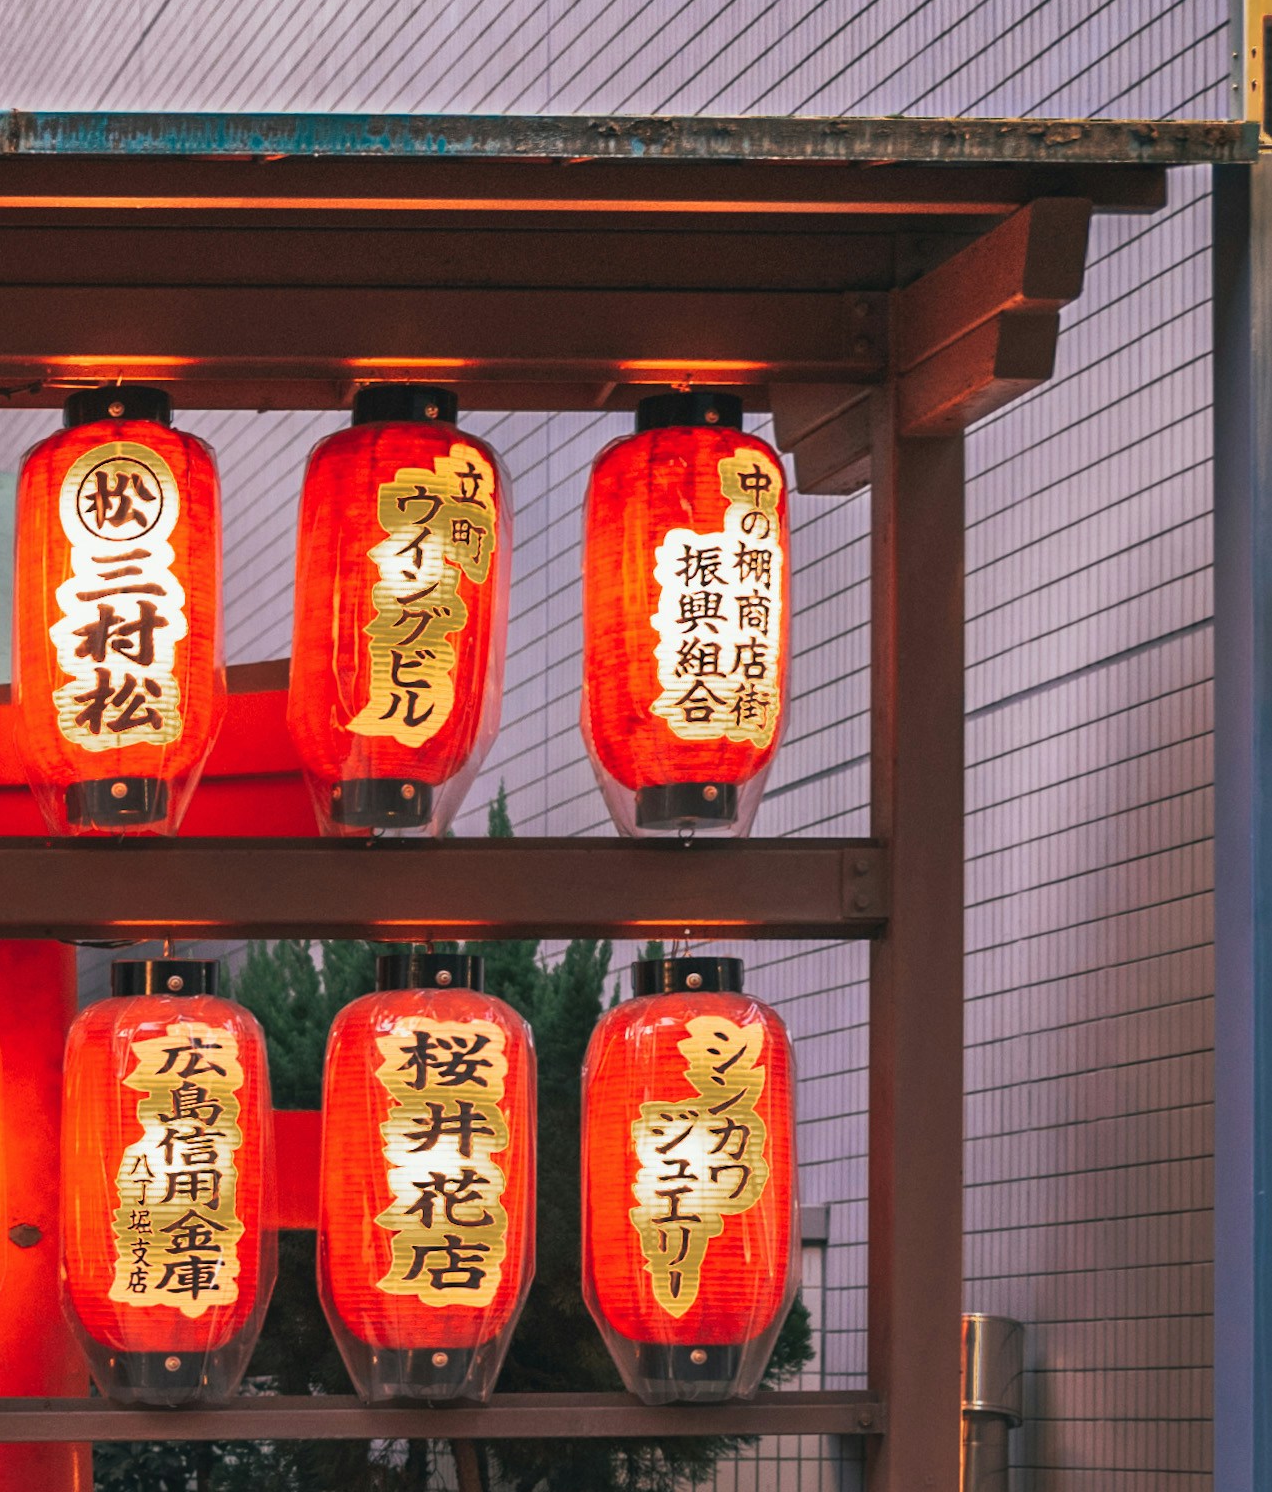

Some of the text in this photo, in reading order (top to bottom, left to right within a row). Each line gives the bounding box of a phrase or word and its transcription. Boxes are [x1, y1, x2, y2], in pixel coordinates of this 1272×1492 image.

[449, 462, 489, 566] 立町
[727, 464, 775, 732] 中の棚商店街
[71, 548, 168, 735] 三村松
[673, 544, 730, 725] 振興組合
[156, 1035, 227, 1300] 広島信用金庫
[395, 1030, 497, 1293] 桜井花店
[649, 1110, 701, 1300] ジュエリー
[706, 1030, 754, 1201] シンカワ
[126, 1154, 157, 1295] 八丁堀支店
